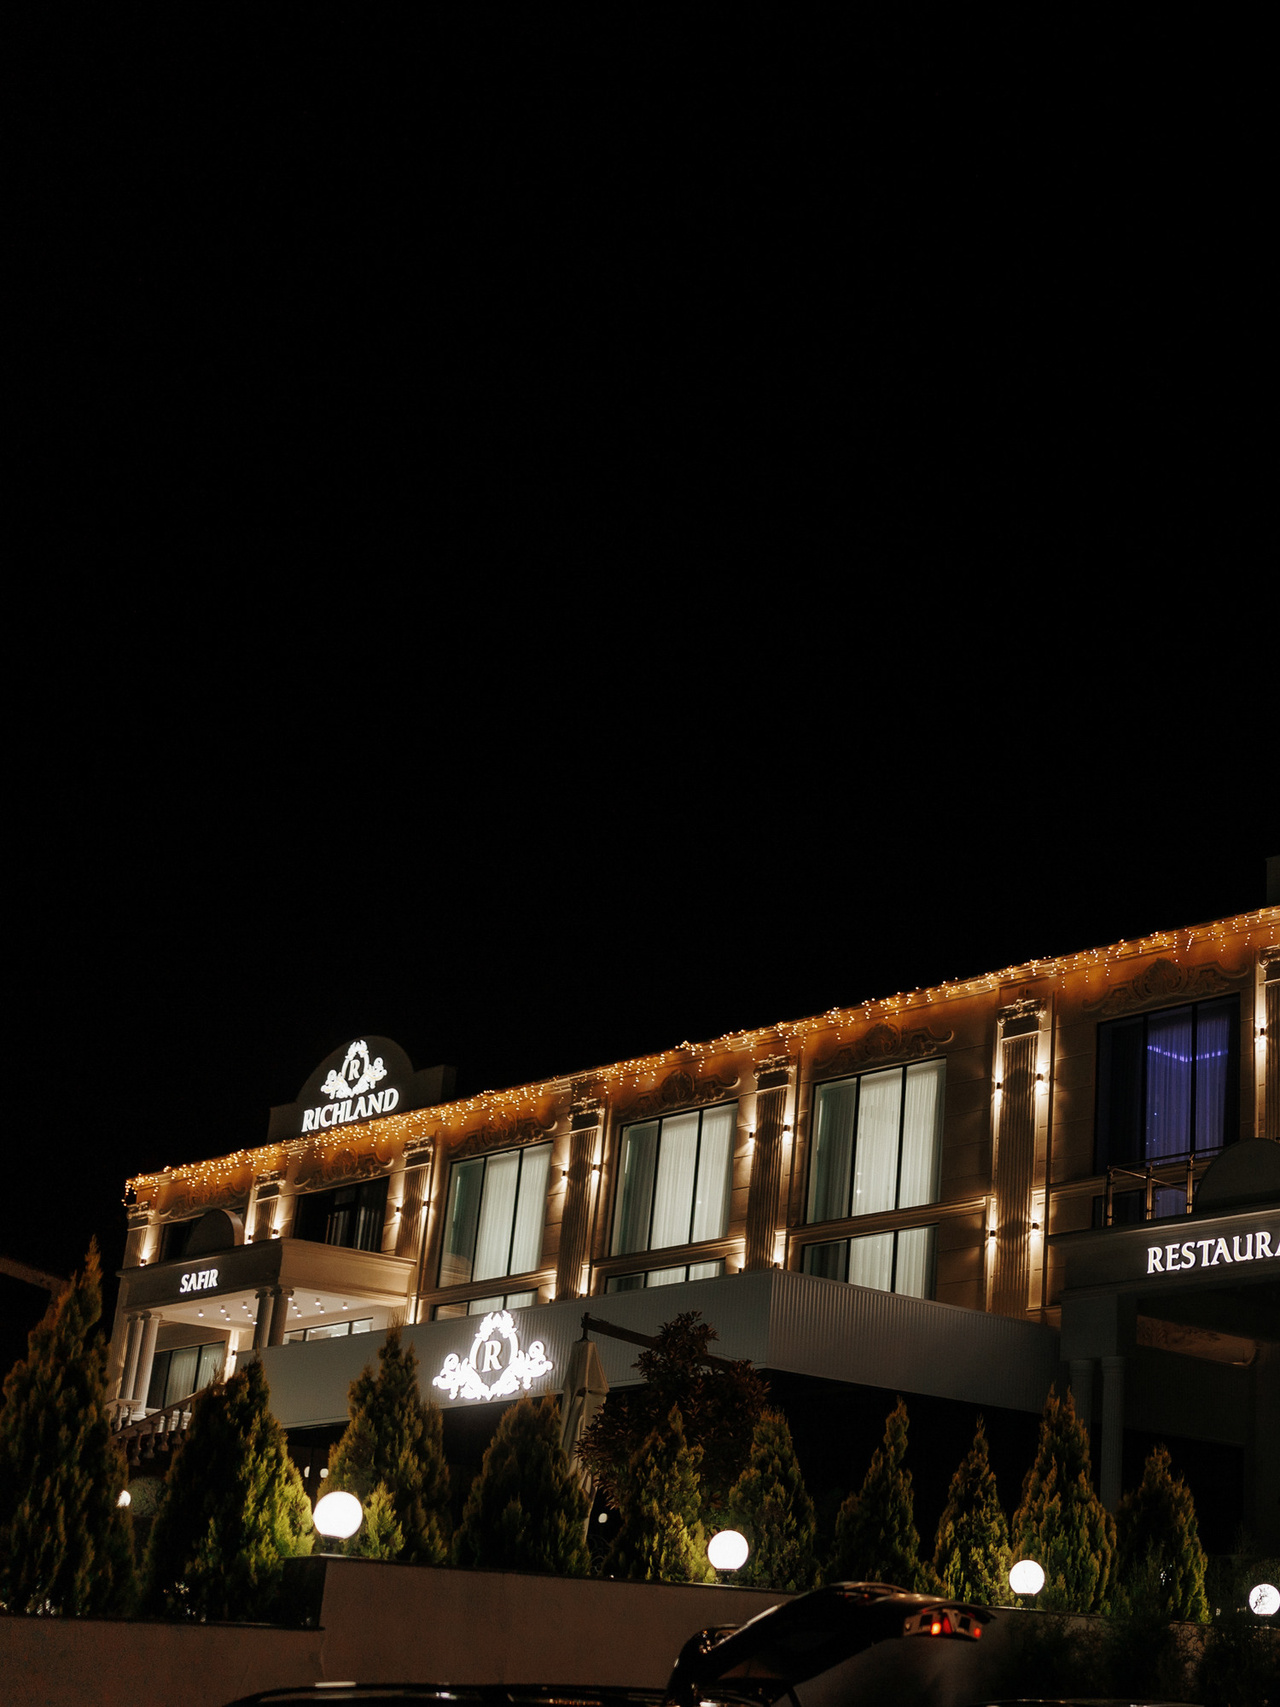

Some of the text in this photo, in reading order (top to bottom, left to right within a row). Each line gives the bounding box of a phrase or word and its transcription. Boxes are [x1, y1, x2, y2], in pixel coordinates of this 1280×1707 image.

[348, 1059, 361, 1081] R
[301, 1088, 400, 1133] RICHLAND
[179, 1268, 219, 1293] SAFIR
[481, 1340, 503, 1373] R
